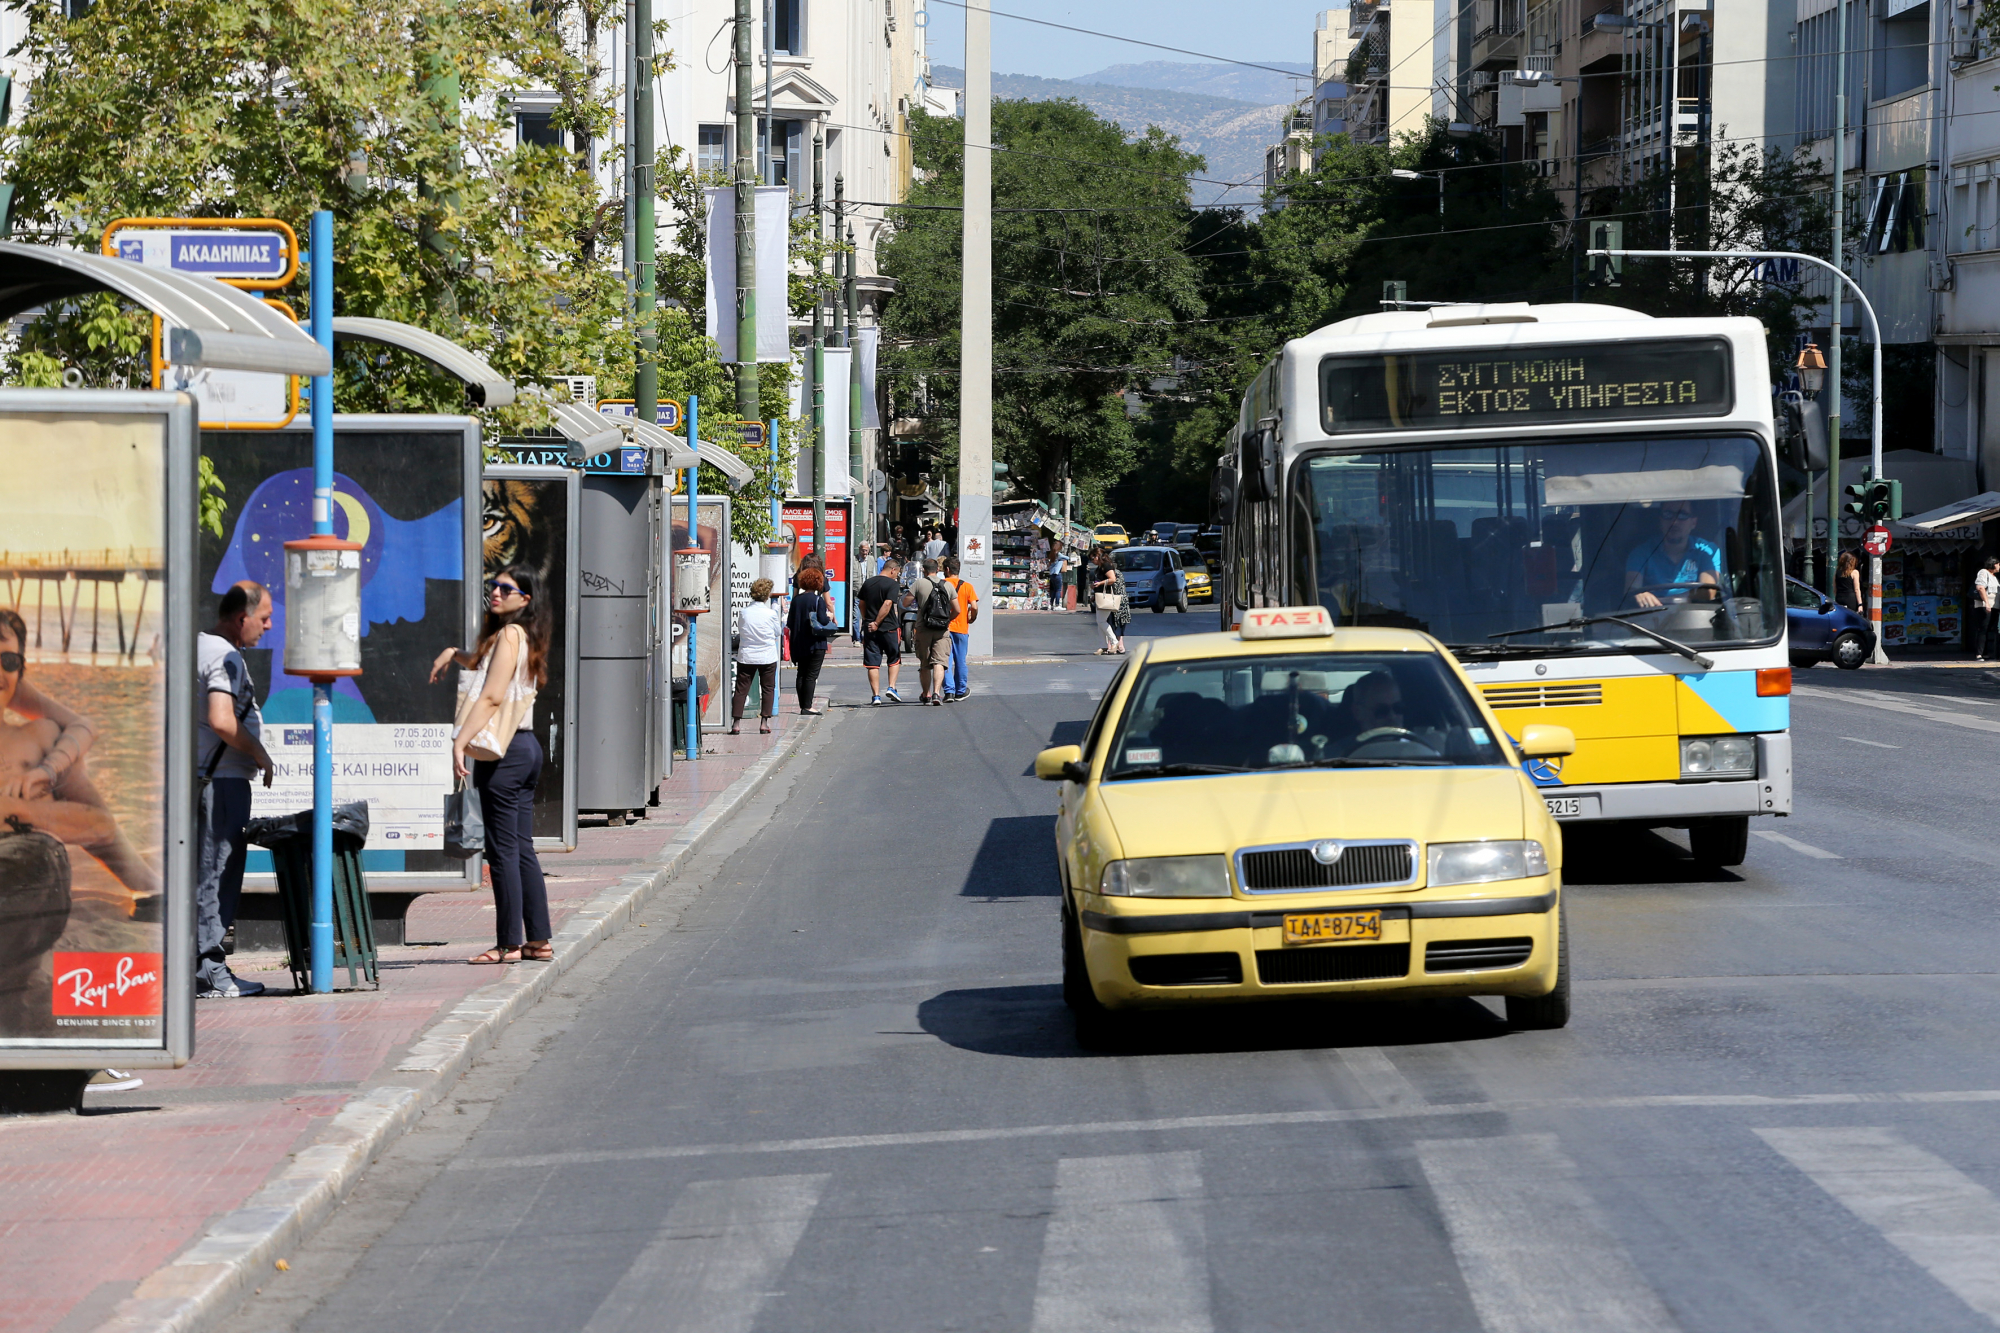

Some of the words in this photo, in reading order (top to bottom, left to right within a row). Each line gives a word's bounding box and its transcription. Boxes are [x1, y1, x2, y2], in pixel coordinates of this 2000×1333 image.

[178, 245, 271, 263] ΑΚΑΔΗΜΙΑΣ
[1438, 358, 1585, 387] ΣΥΓΓΝΩΜΗ
[1439, 388, 1531, 415] ΕΚΤΟΣ
[1549, 380, 1697, 410] ΥΠΗΡΕΣΙΑ
[1249, 612, 1323, 626] ΤΑΞΙ
[393, 728, 445, 738] 27.05.2016
[343, 763, 368, 776] ΚΑΙ
[372, 763, 419, 776] ΗΘΙΚΗ
[57, 1018, 99, 1026] GENUINE
[102, 1018, 131, 1026] SINCE
[134, 1018, 156, 1026] 1937
